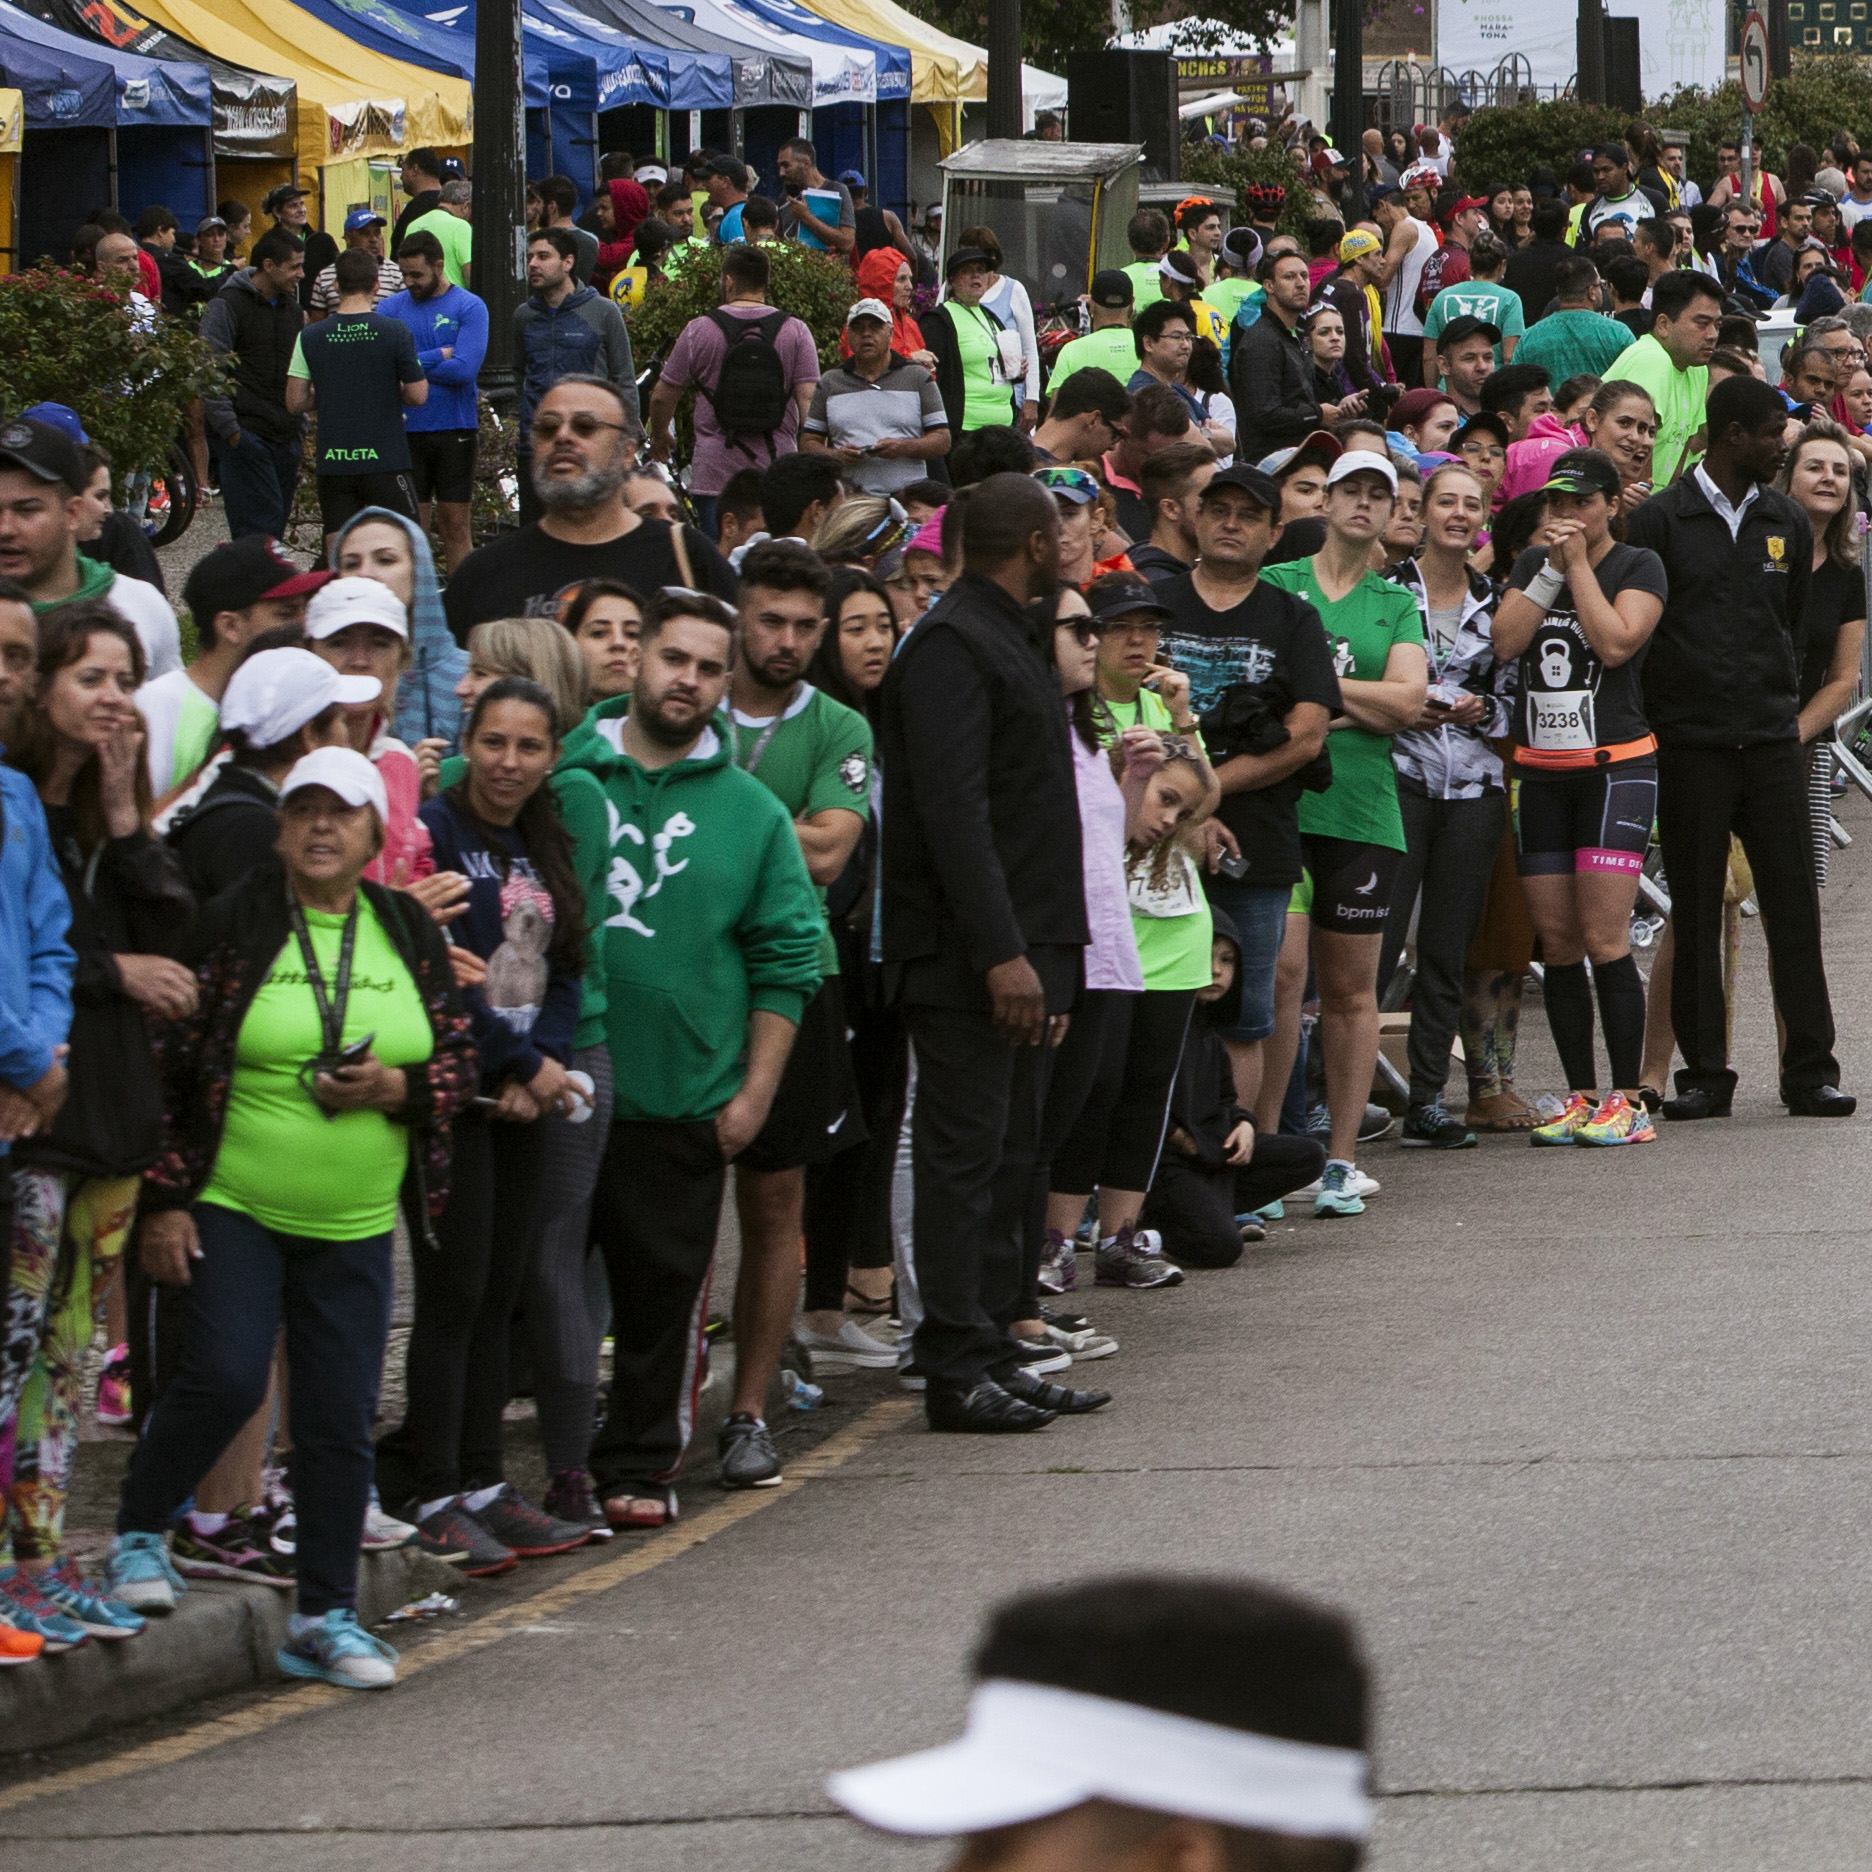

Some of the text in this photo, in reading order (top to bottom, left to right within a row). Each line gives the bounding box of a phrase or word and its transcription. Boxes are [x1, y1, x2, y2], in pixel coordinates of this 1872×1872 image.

[325, 448, 379, 461] ATLETA
[1538, 712, 1580, 728] 3238
[1592, 855, 1625, 866] TIME
